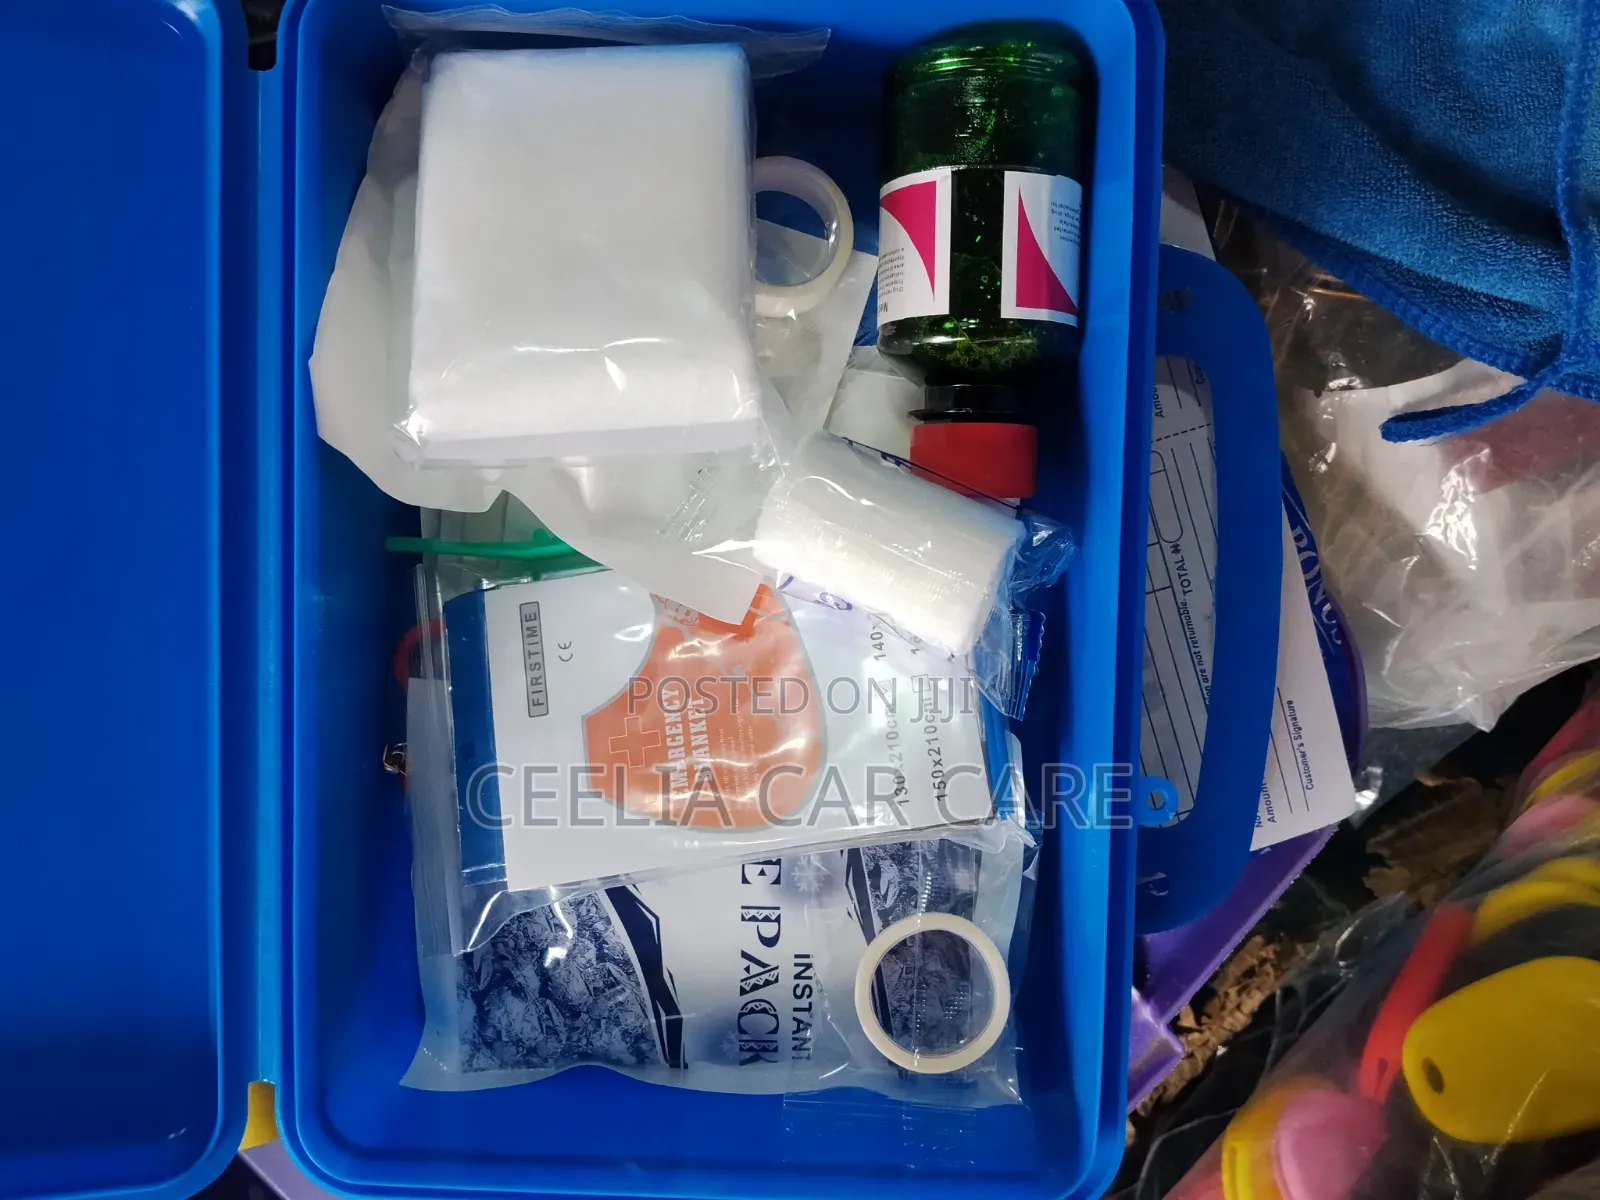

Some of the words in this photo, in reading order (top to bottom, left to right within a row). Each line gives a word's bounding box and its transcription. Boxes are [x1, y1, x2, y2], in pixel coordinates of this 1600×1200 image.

[1175, 556, 1194, 596] TOTAL
[1179, 598, 1201, 649] returnable.
[524, 611, 545, 708] FIRSTIME
[1194, 650, 1206, 666] not
[1199, 668, 1210, 683] are
[1286, 699, 1303, 742] Signature
[919, 696, 949, 802] 150x210cm
[1298, 742, 1314, 791] Customer's
[737, 904, 782, 1066] PACK
